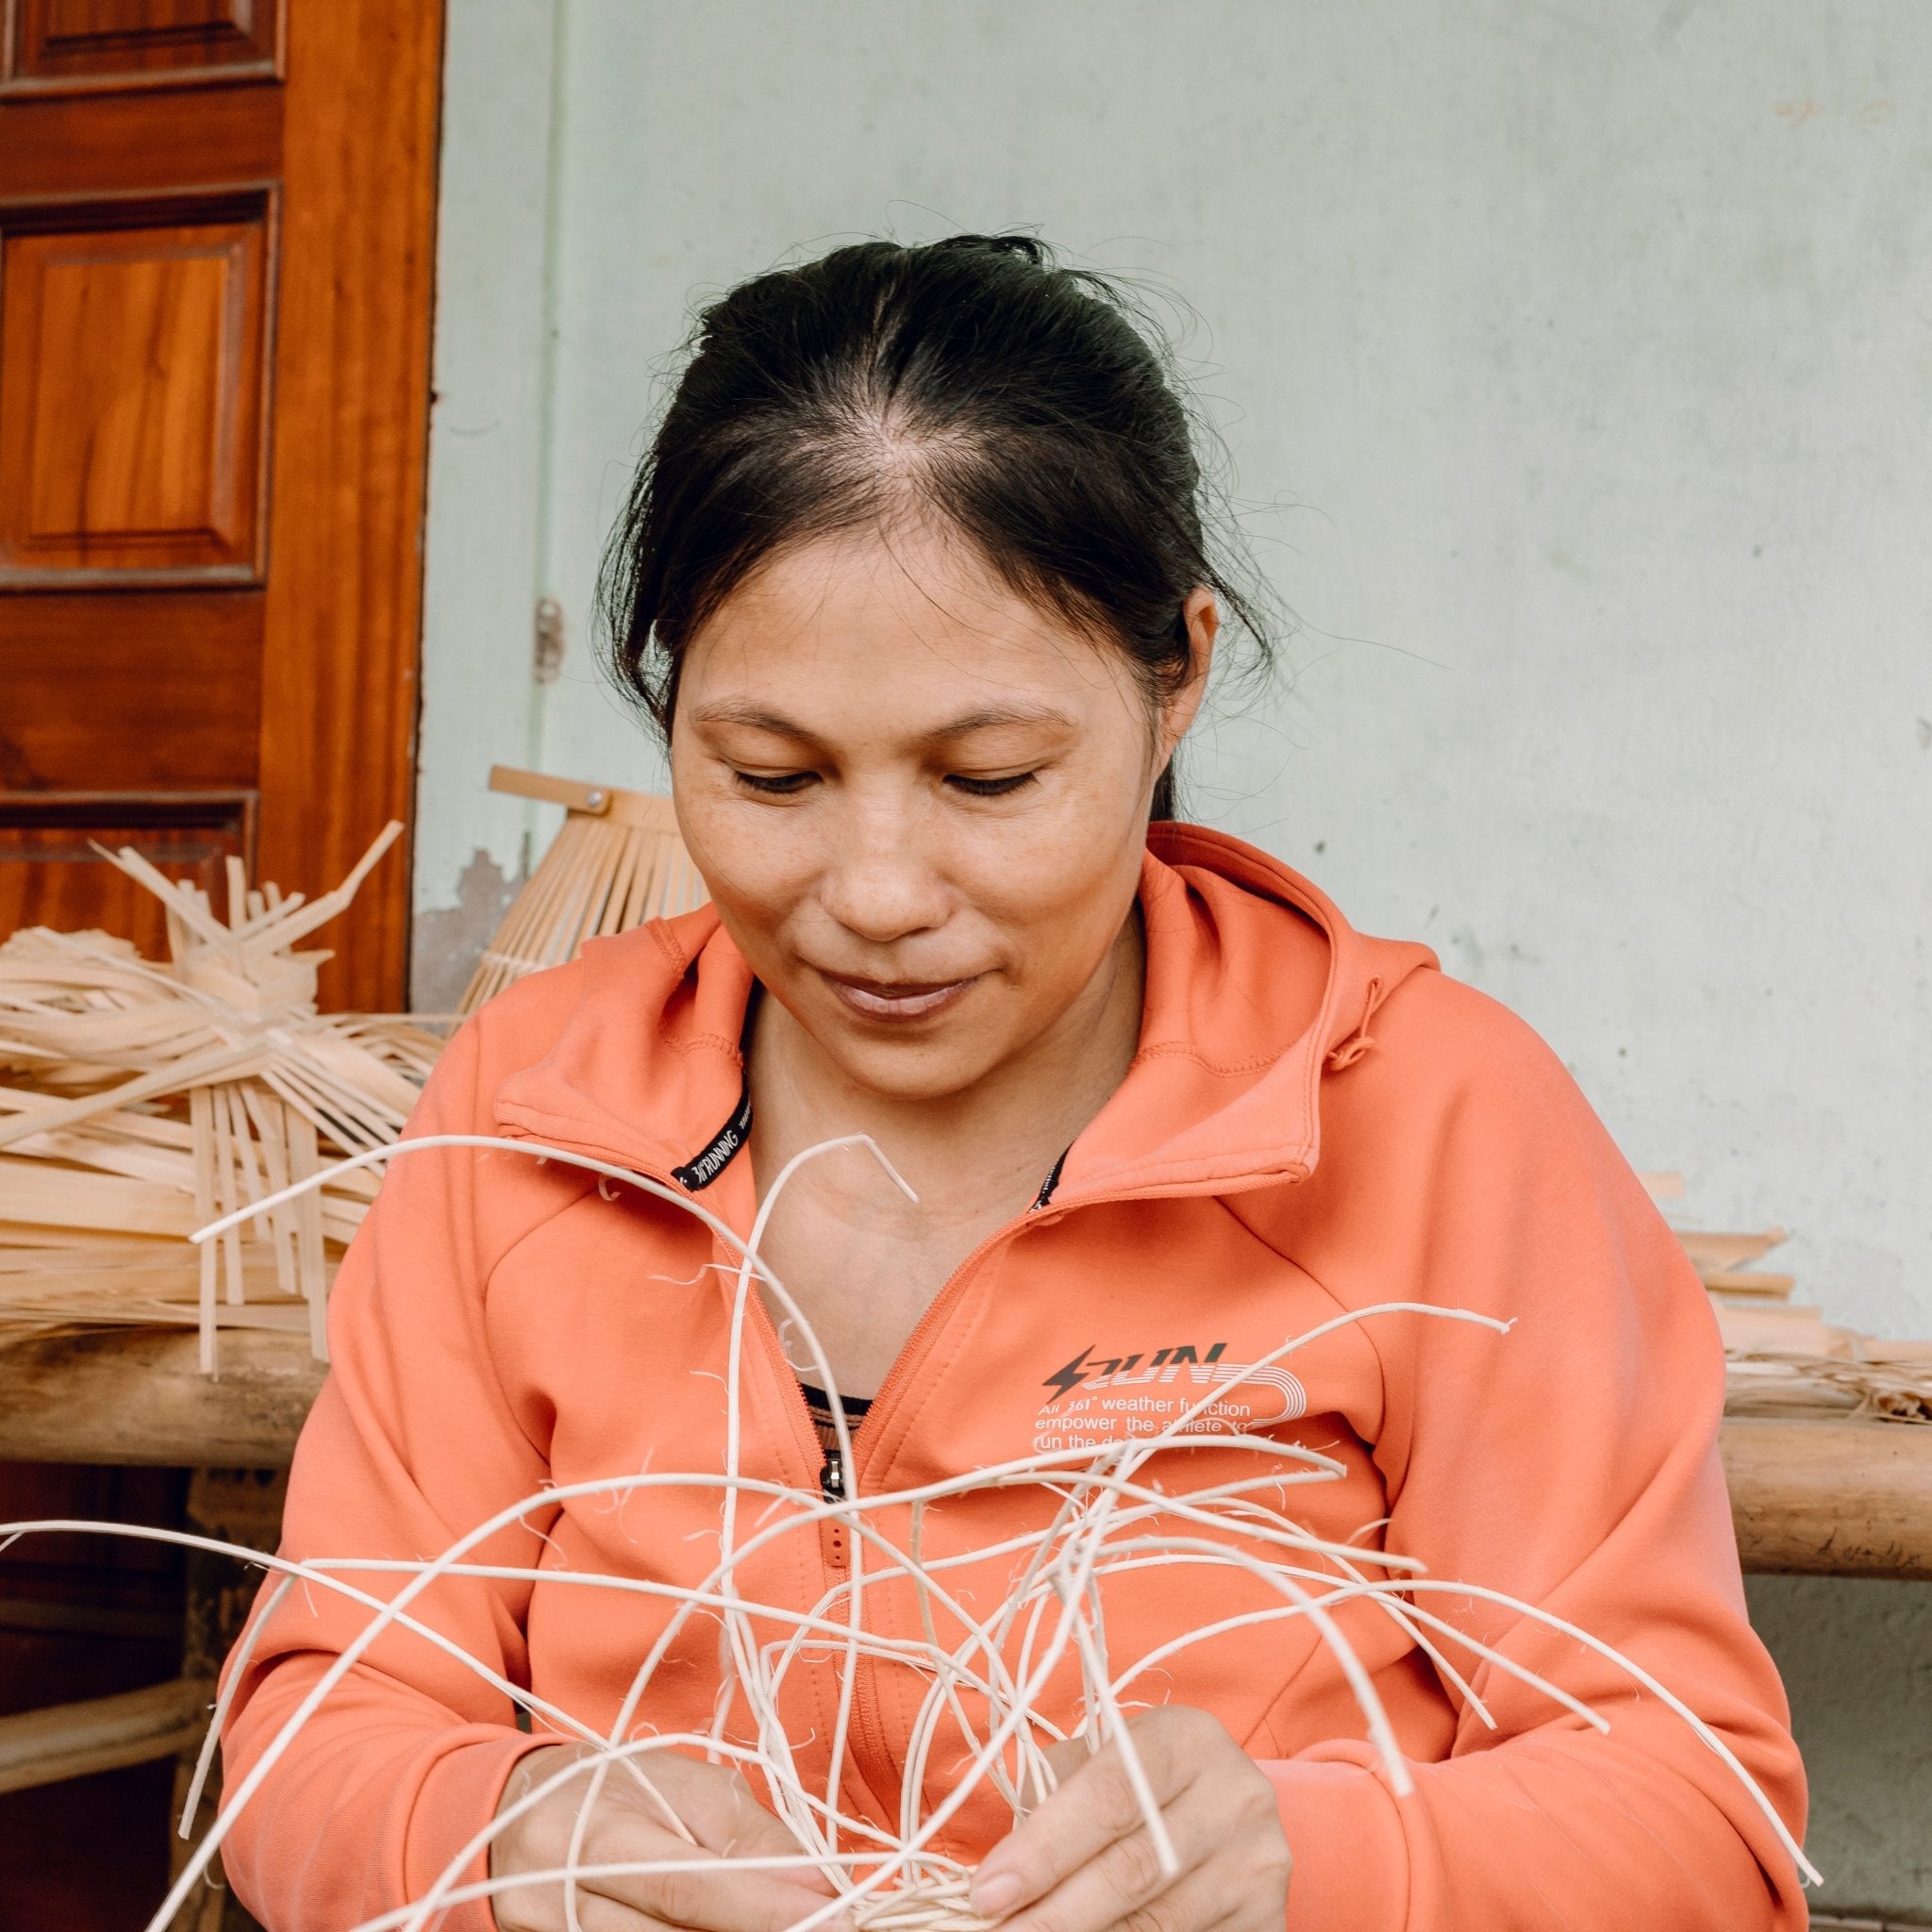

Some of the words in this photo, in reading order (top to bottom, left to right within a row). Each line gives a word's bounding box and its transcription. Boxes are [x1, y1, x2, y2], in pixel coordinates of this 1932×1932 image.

[1038, 1404, 1060, 1416] All
[1102, 1395, 1174, 1413] weather
[1179, 1397, 1250, 1416] fuction
[1034, 1417, 1118, 1432] empower
[1125, 1415, 1155, 1432] the
[1033, 1436, 1062, 1449] run
[1068, 1434, 1096, 1449] the
